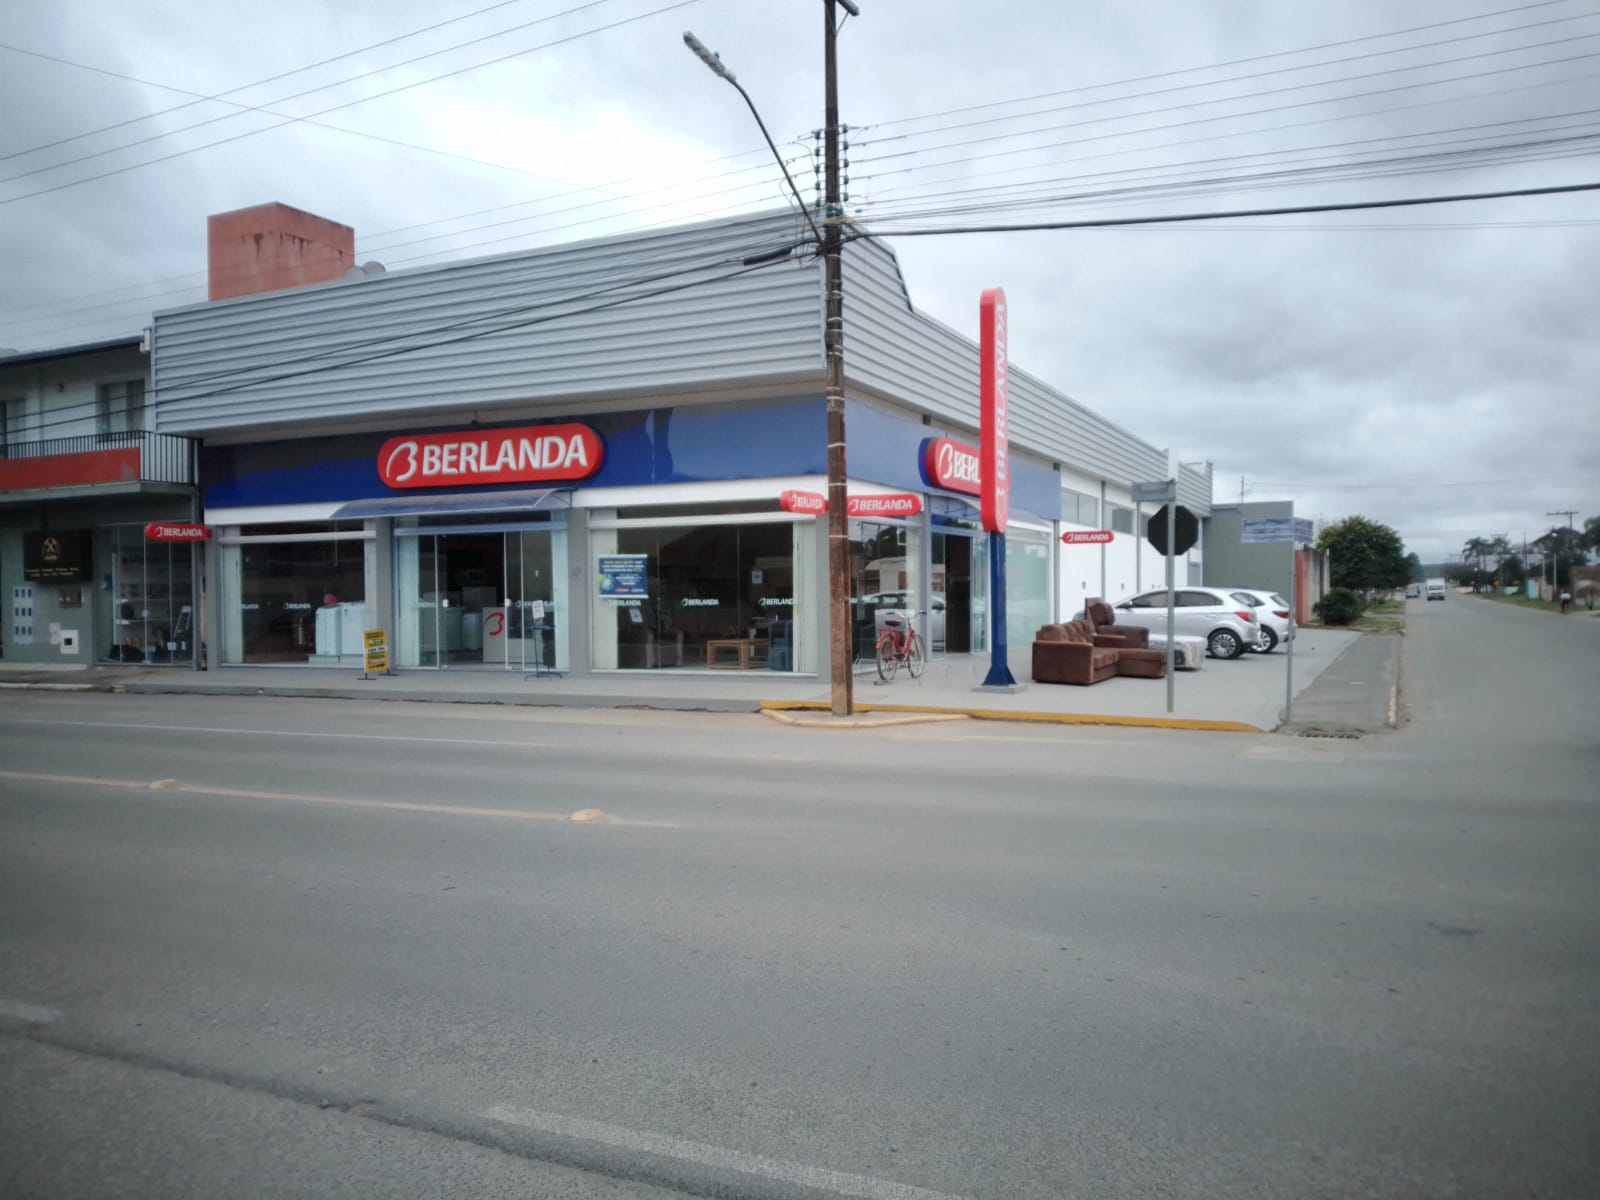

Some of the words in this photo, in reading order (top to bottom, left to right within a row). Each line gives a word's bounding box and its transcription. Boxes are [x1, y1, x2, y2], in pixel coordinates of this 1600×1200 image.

[422, 434, 588, 476] BERLANDA
[953, 450, 981, 485] BERL
[797, 496, 823, 509] BERLANDA
[860, 498, 913, 511] BERLANDA
[163, 528, 202, 537] BERLANDA
[1073, 533, 1109, 541] BERLANDA
[688, 598, 719, 606] BERLANDA
